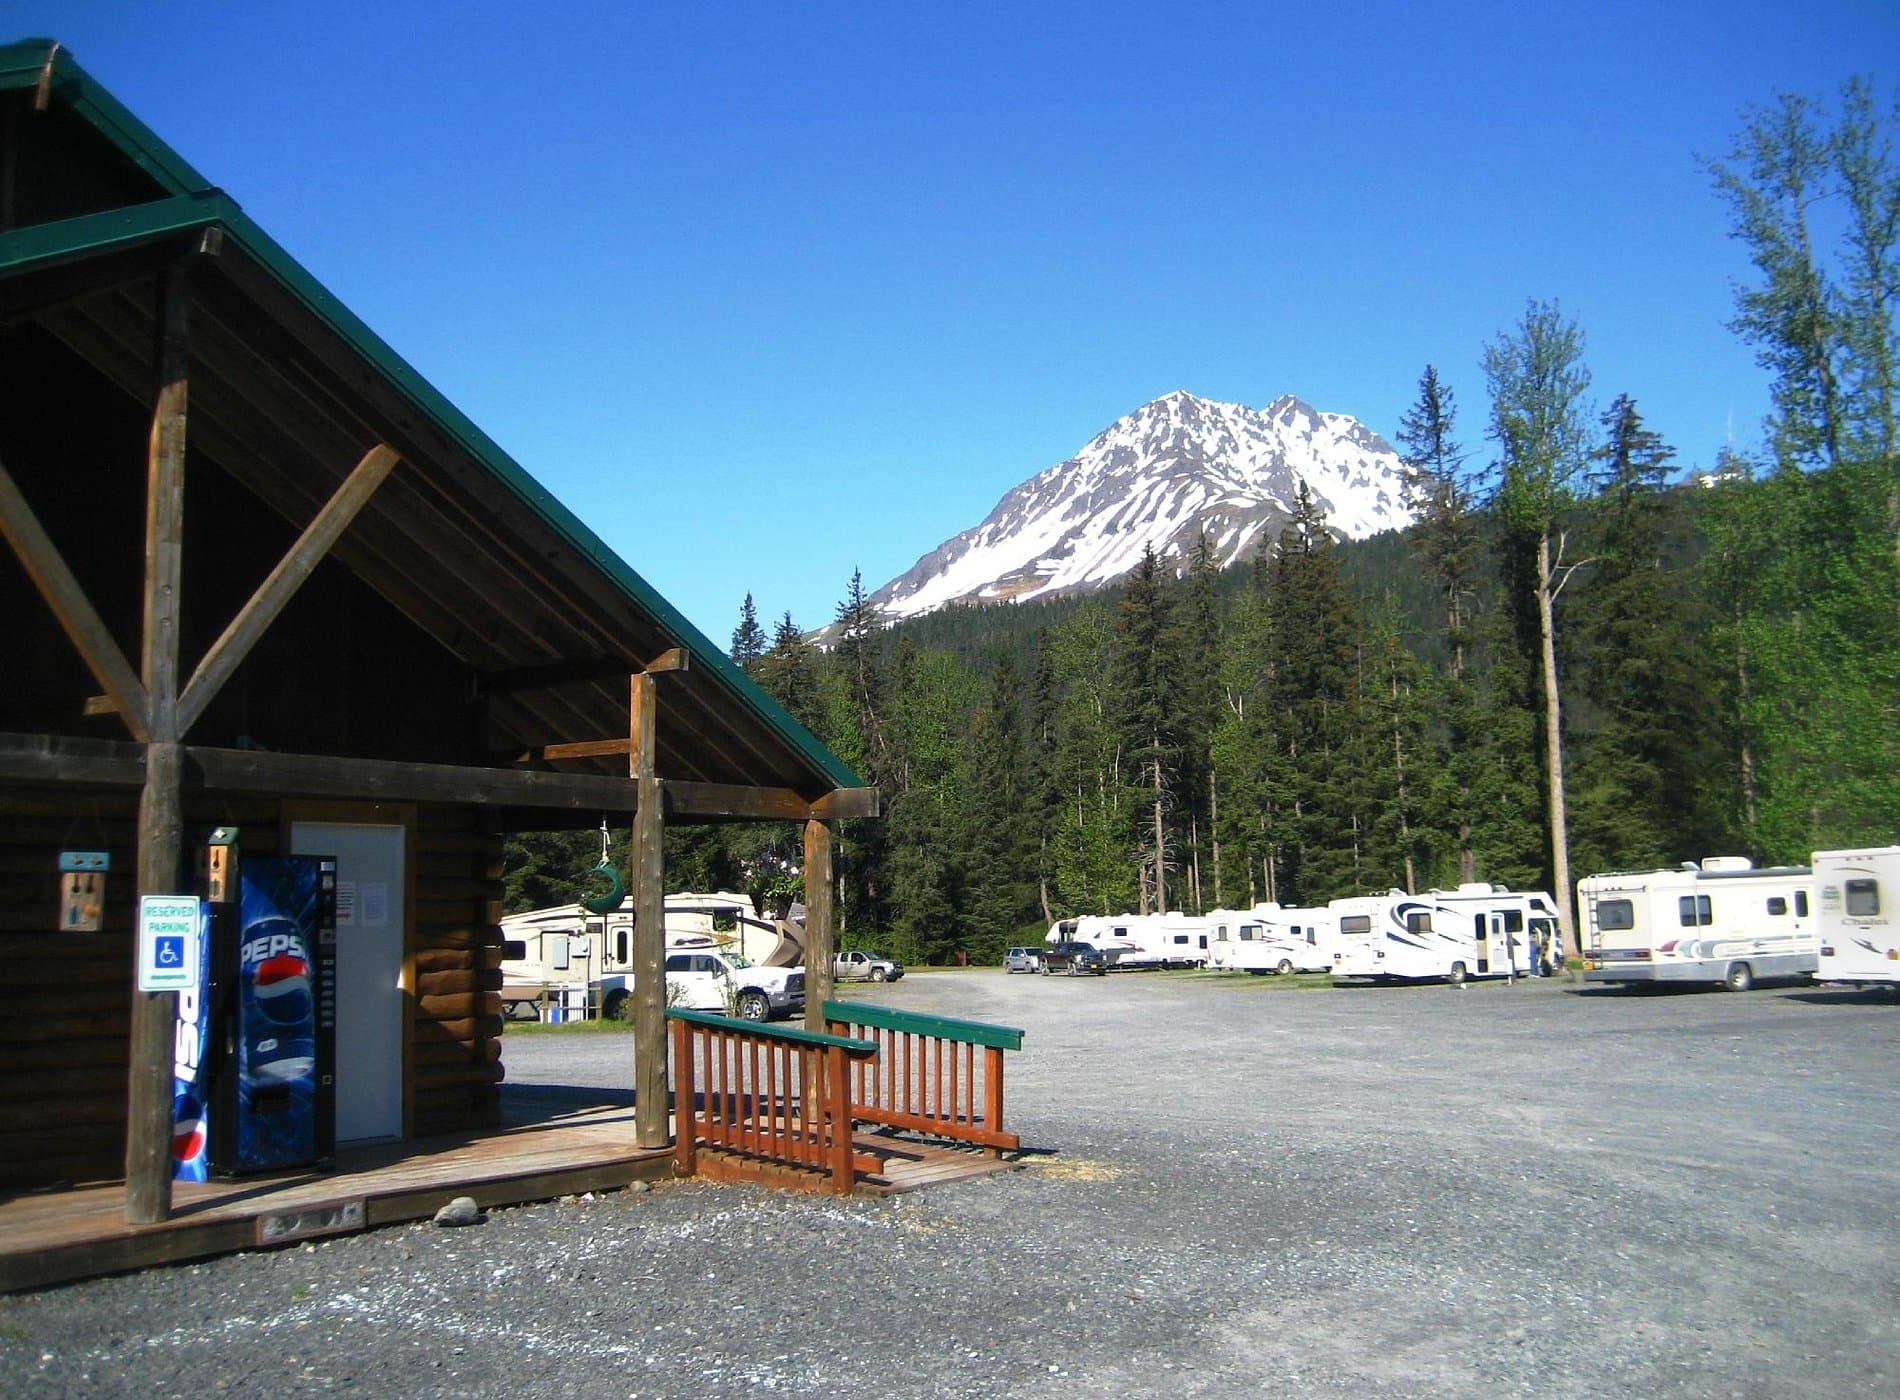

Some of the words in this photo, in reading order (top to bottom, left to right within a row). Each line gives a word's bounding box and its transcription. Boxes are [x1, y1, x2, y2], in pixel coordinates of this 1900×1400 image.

[144, 905, 194, 917] RESERVED
[149, 922, 190, 933] PARKING
[241, 934, 306, 964] PEPS
[175, 988, 199, 1083] PSI
